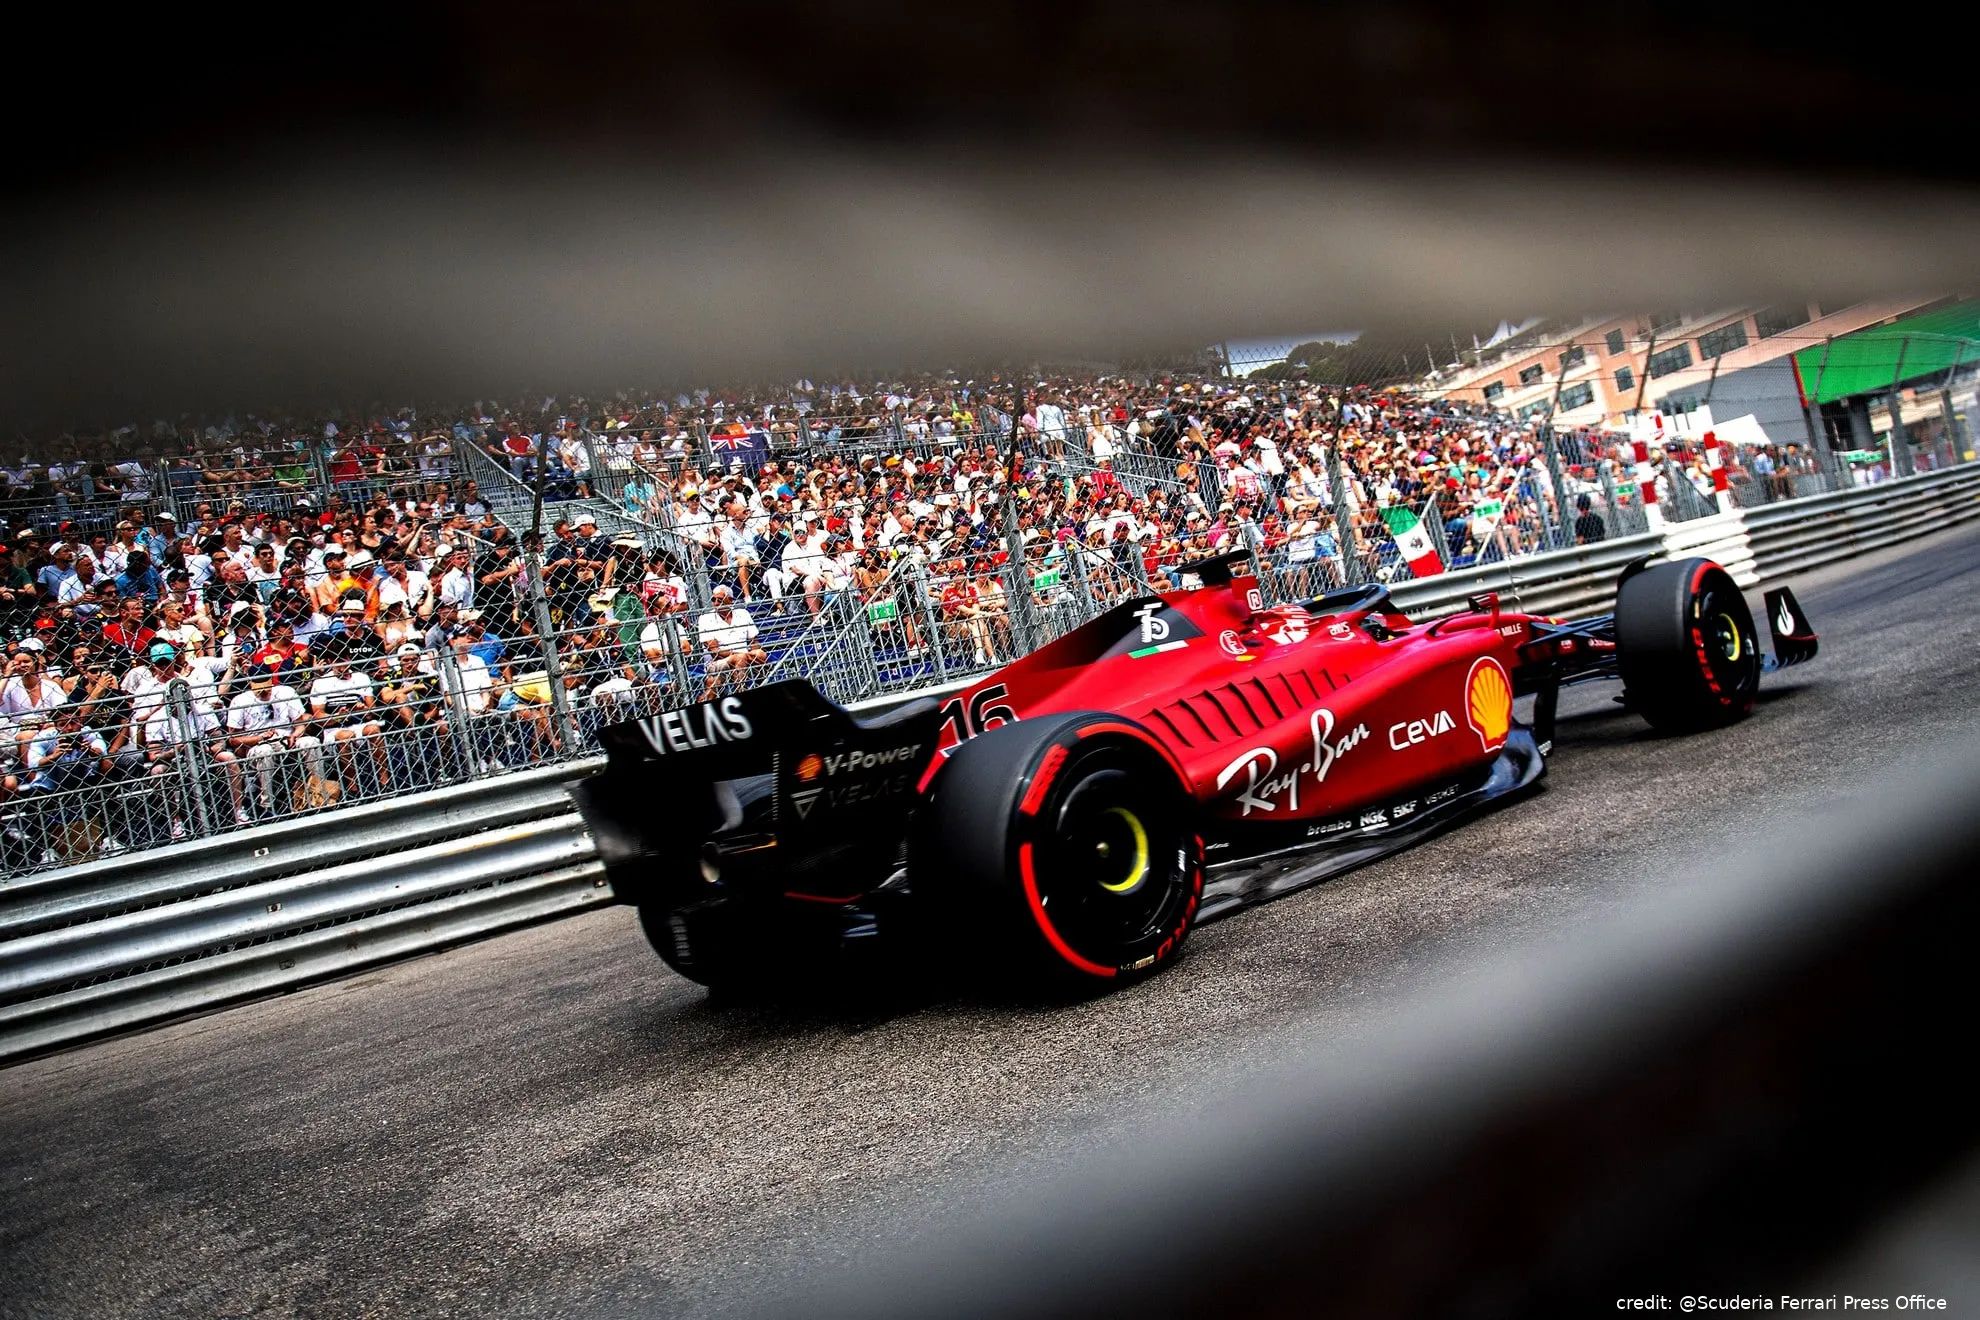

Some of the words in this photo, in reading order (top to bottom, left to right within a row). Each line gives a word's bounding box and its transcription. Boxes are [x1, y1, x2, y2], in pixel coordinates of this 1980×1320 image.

[1501, 623, 1523, 637] MILLE
[638, 697, 753, 755] VELAS
[939, 682, 1019, 757] 16
[823, 743, 922, 776] V-Power
[828, 774, 909, 808] VELAS
[1360, 809, 1388, 827] NGK
[1393, 800, 1418, 818] SKF
